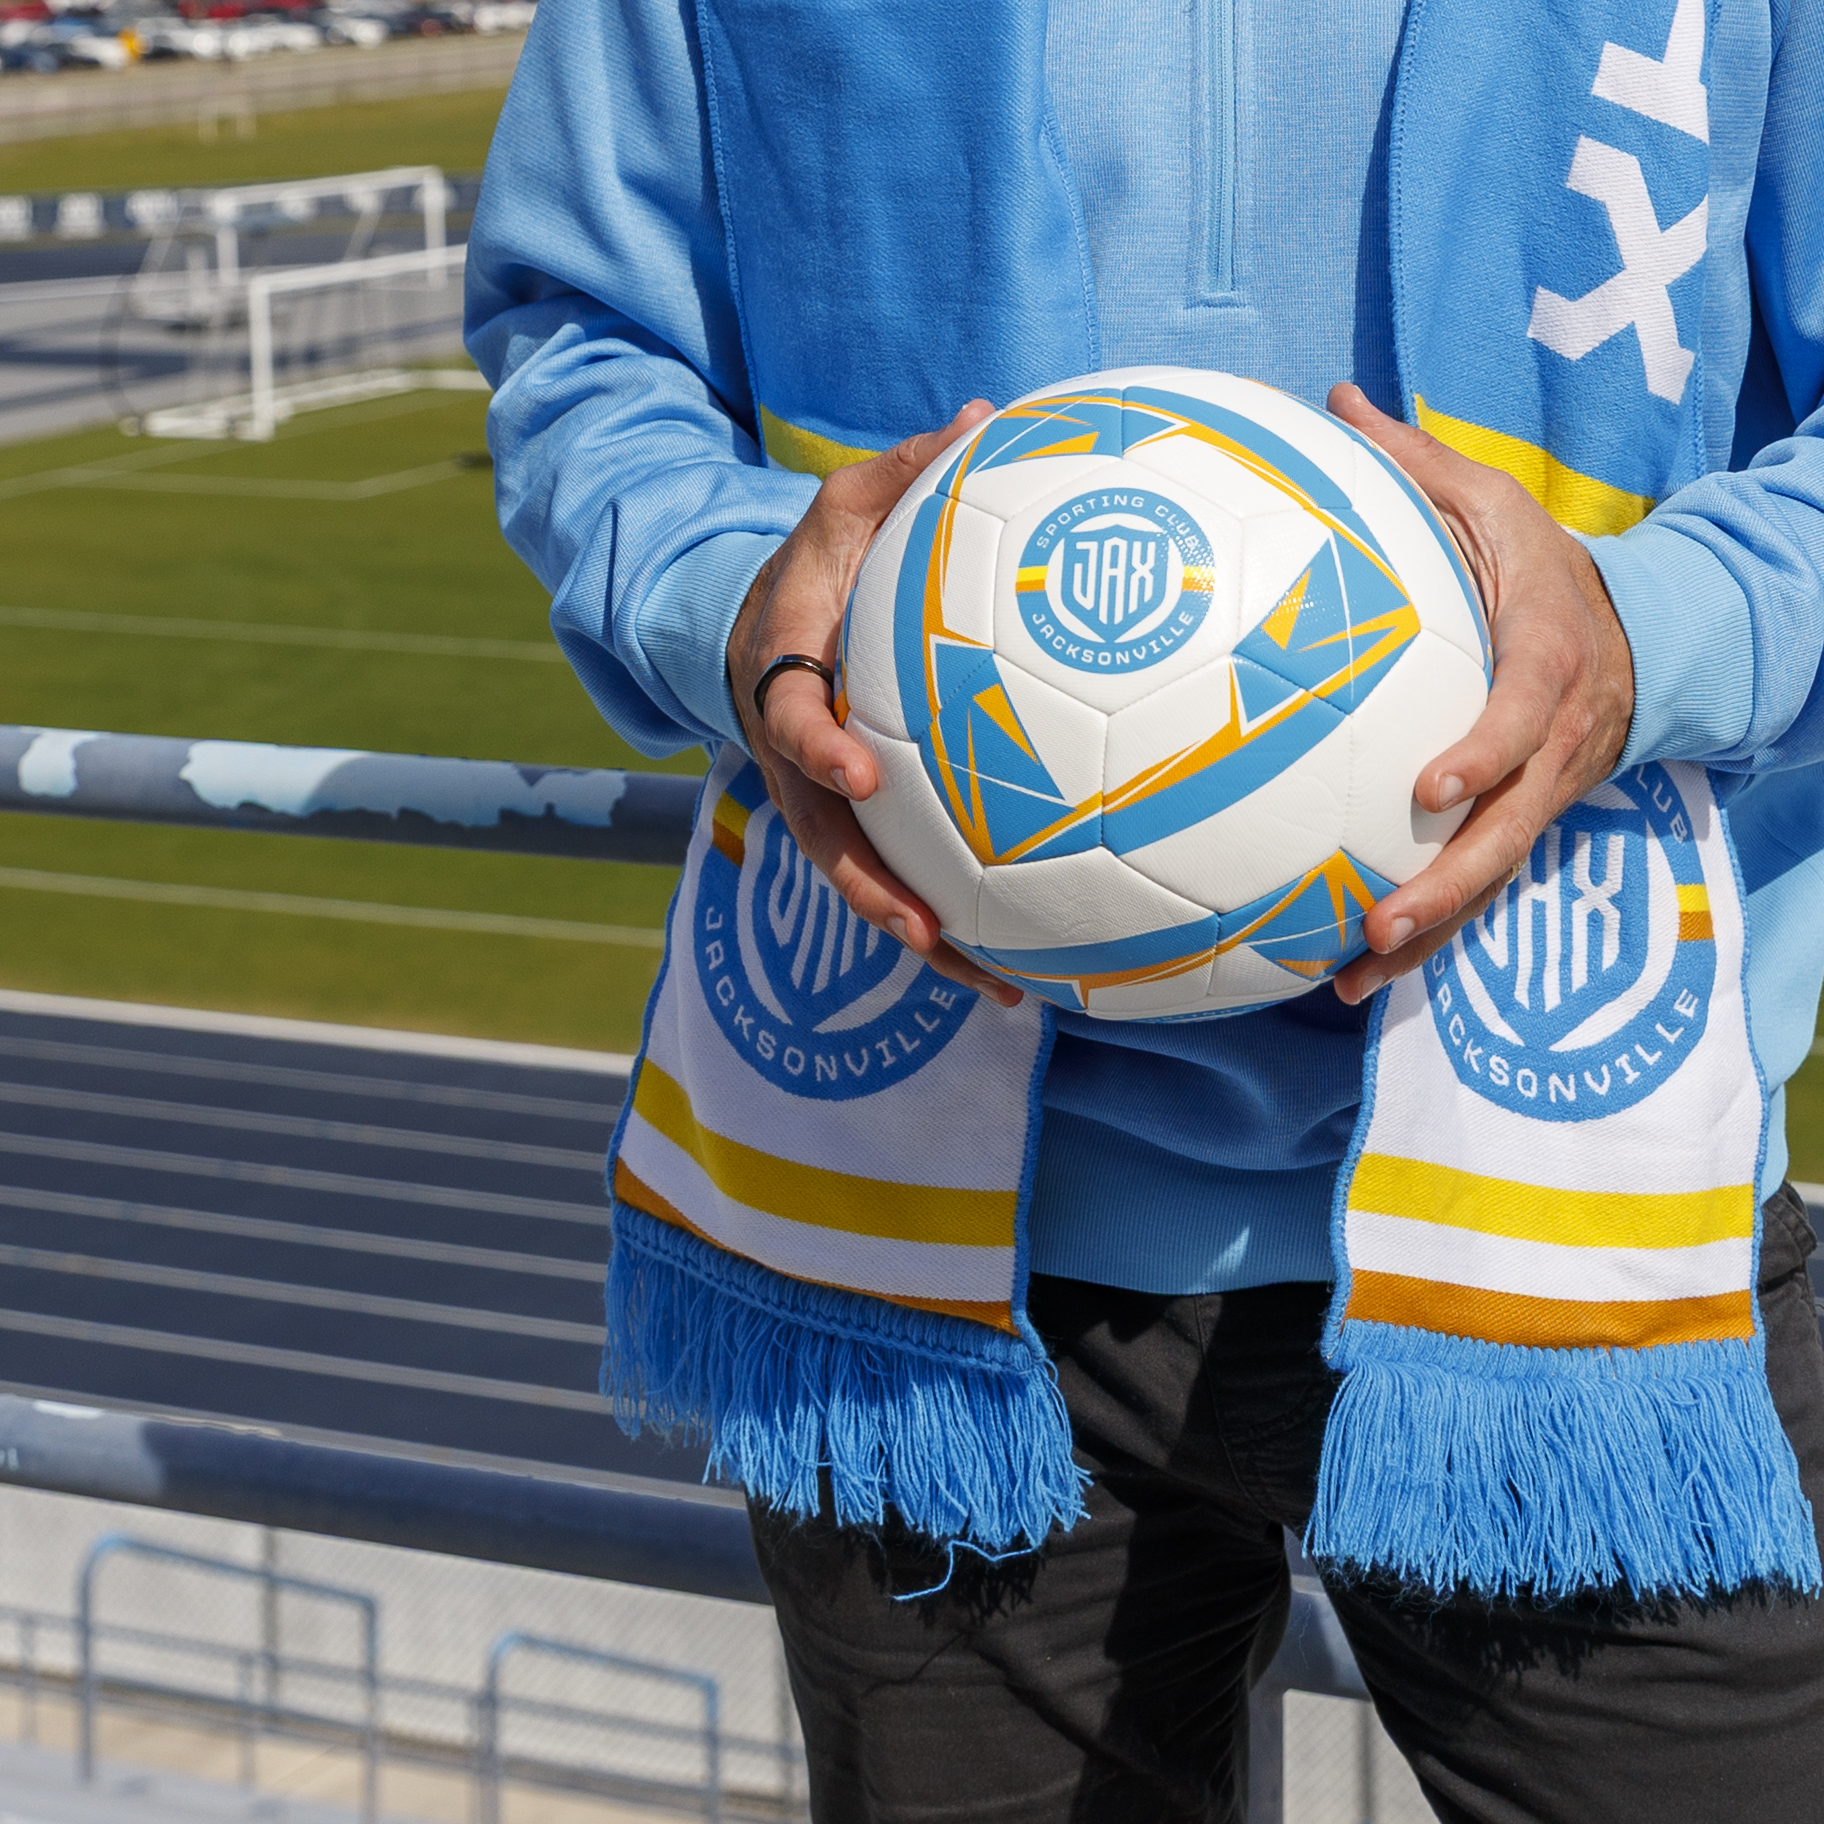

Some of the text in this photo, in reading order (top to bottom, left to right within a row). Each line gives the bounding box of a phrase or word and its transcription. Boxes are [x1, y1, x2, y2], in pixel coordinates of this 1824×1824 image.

[1037, 494, 1200, 549] SPORTING CLUB
[1072, 536, 1156, 625] JAX
[1032, 612, 1194, 665] JACKSONVILLE
[1637, 762, 1688, 844] LUB
[705, 906, 957, 1083] JACKSONVILLE
[1432, 954, 1699, 1103] JACKSONVILLE
